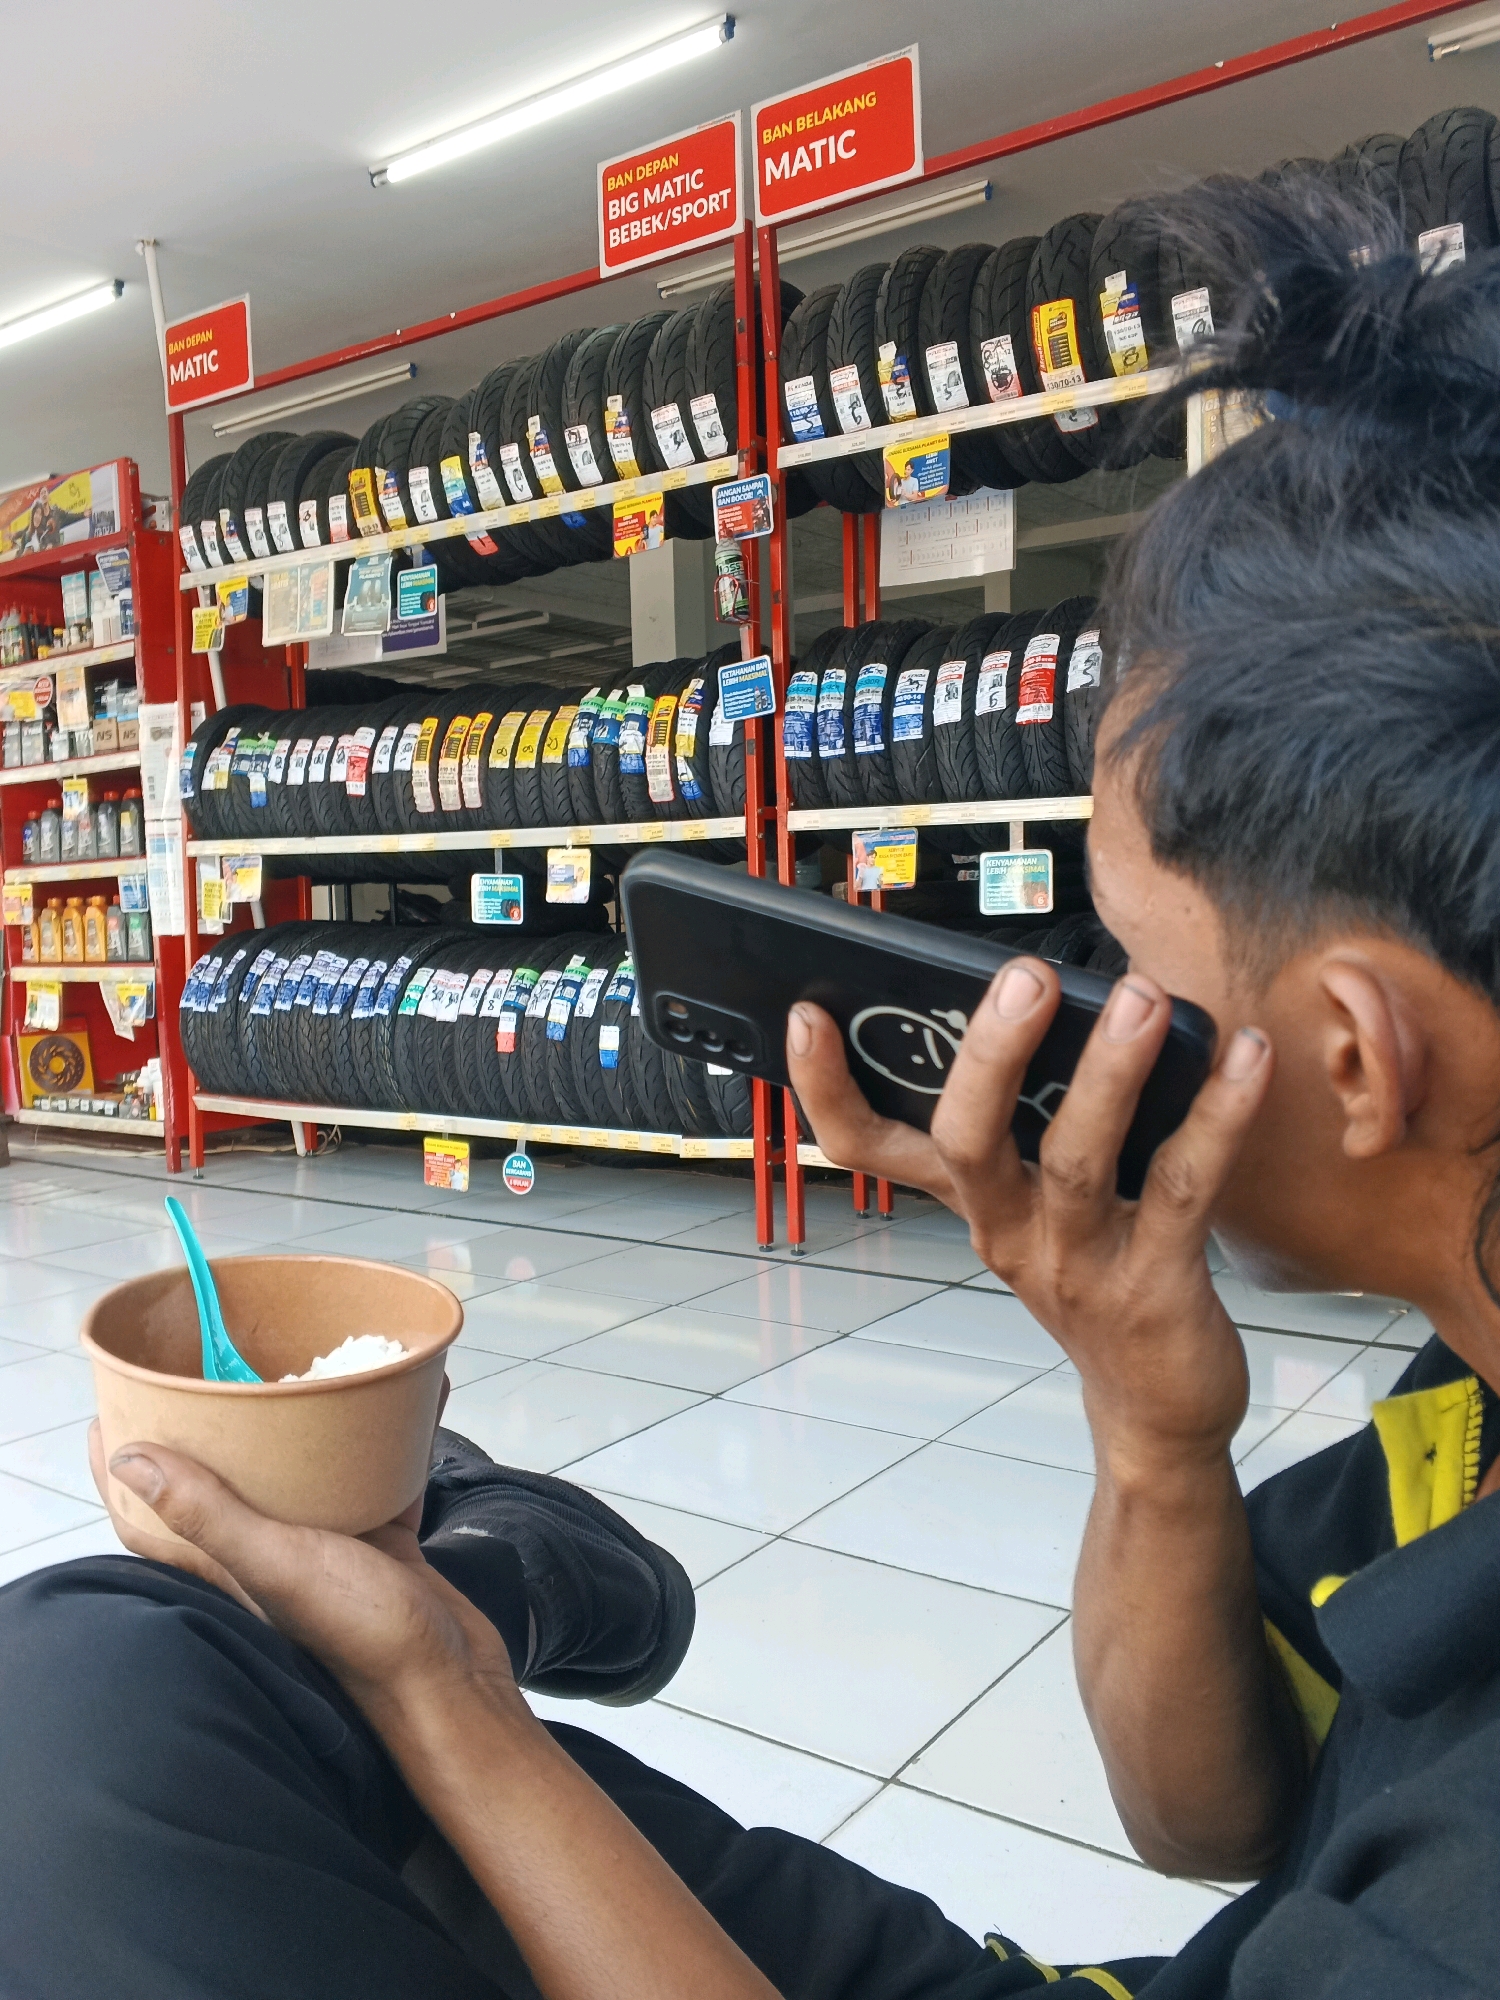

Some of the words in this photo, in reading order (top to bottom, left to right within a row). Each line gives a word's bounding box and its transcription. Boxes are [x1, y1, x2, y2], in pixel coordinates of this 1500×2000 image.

[762, 120, 793, 145] BAN
[796, 91, 877, 133] BELAKANG
[764, 129, 858, 186] MATIC
[607, 169, 634, 192] BAN
[636, 152, 680, 182] DEPAN
[608, 191, 640, 221] BIG
[643, 168, 705, 206] MATIC
[609, 187, 732, 248] BEBEK/SPORT
[168, 339, 185, 356] BAN
[186, 328, 213, 349] DEPAN
[169, 348, 219, 386] MATIC
[1046, 374, 1083, 391] 130/70-13
[717, 487, 742, 499] JANGAN
[741, 480, 764, 493] SAMPAI
[721, 664, 756, 680] KETAHANAN
[755, 660, 768, 670] BAN
[722, 677, 739, 687] LEBIH
[738, 669, 768, 683] MAKSIMAL
[988, 690, 1000, 708] 6
[122, 730, 137, 741] NS
[986, 857, 1038, 867] KENYAMANAN
[986, 866, 1007, 875] LEBIH
[512, 1159, 526, 1169] BAN
